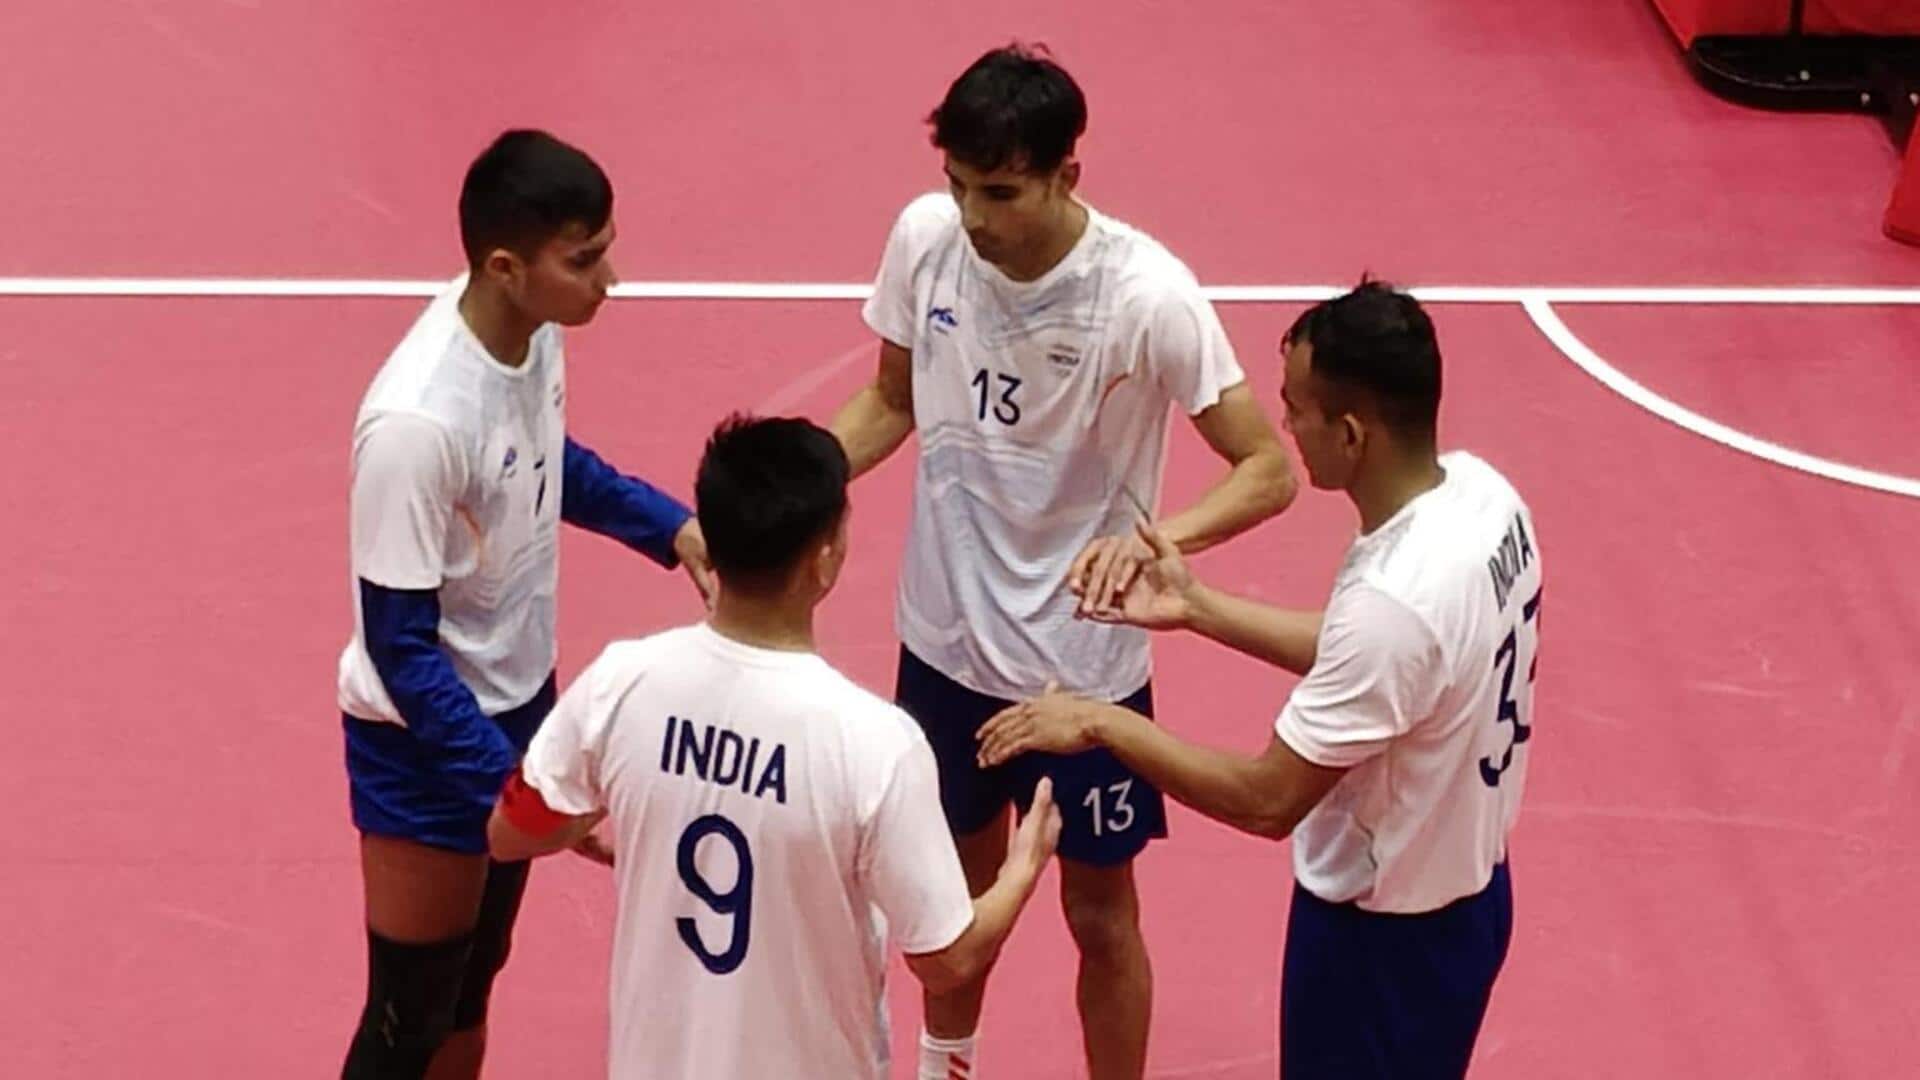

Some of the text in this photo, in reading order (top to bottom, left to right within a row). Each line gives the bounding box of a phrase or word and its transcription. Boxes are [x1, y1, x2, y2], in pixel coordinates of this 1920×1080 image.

[971, 367, 1023, 426] 13
[532, 453, 547, 517] 7
[660, 715, 787, 804] INDIA
[1081, 776, 1135, 836] 13
[675, 813, 754, 975] 9
